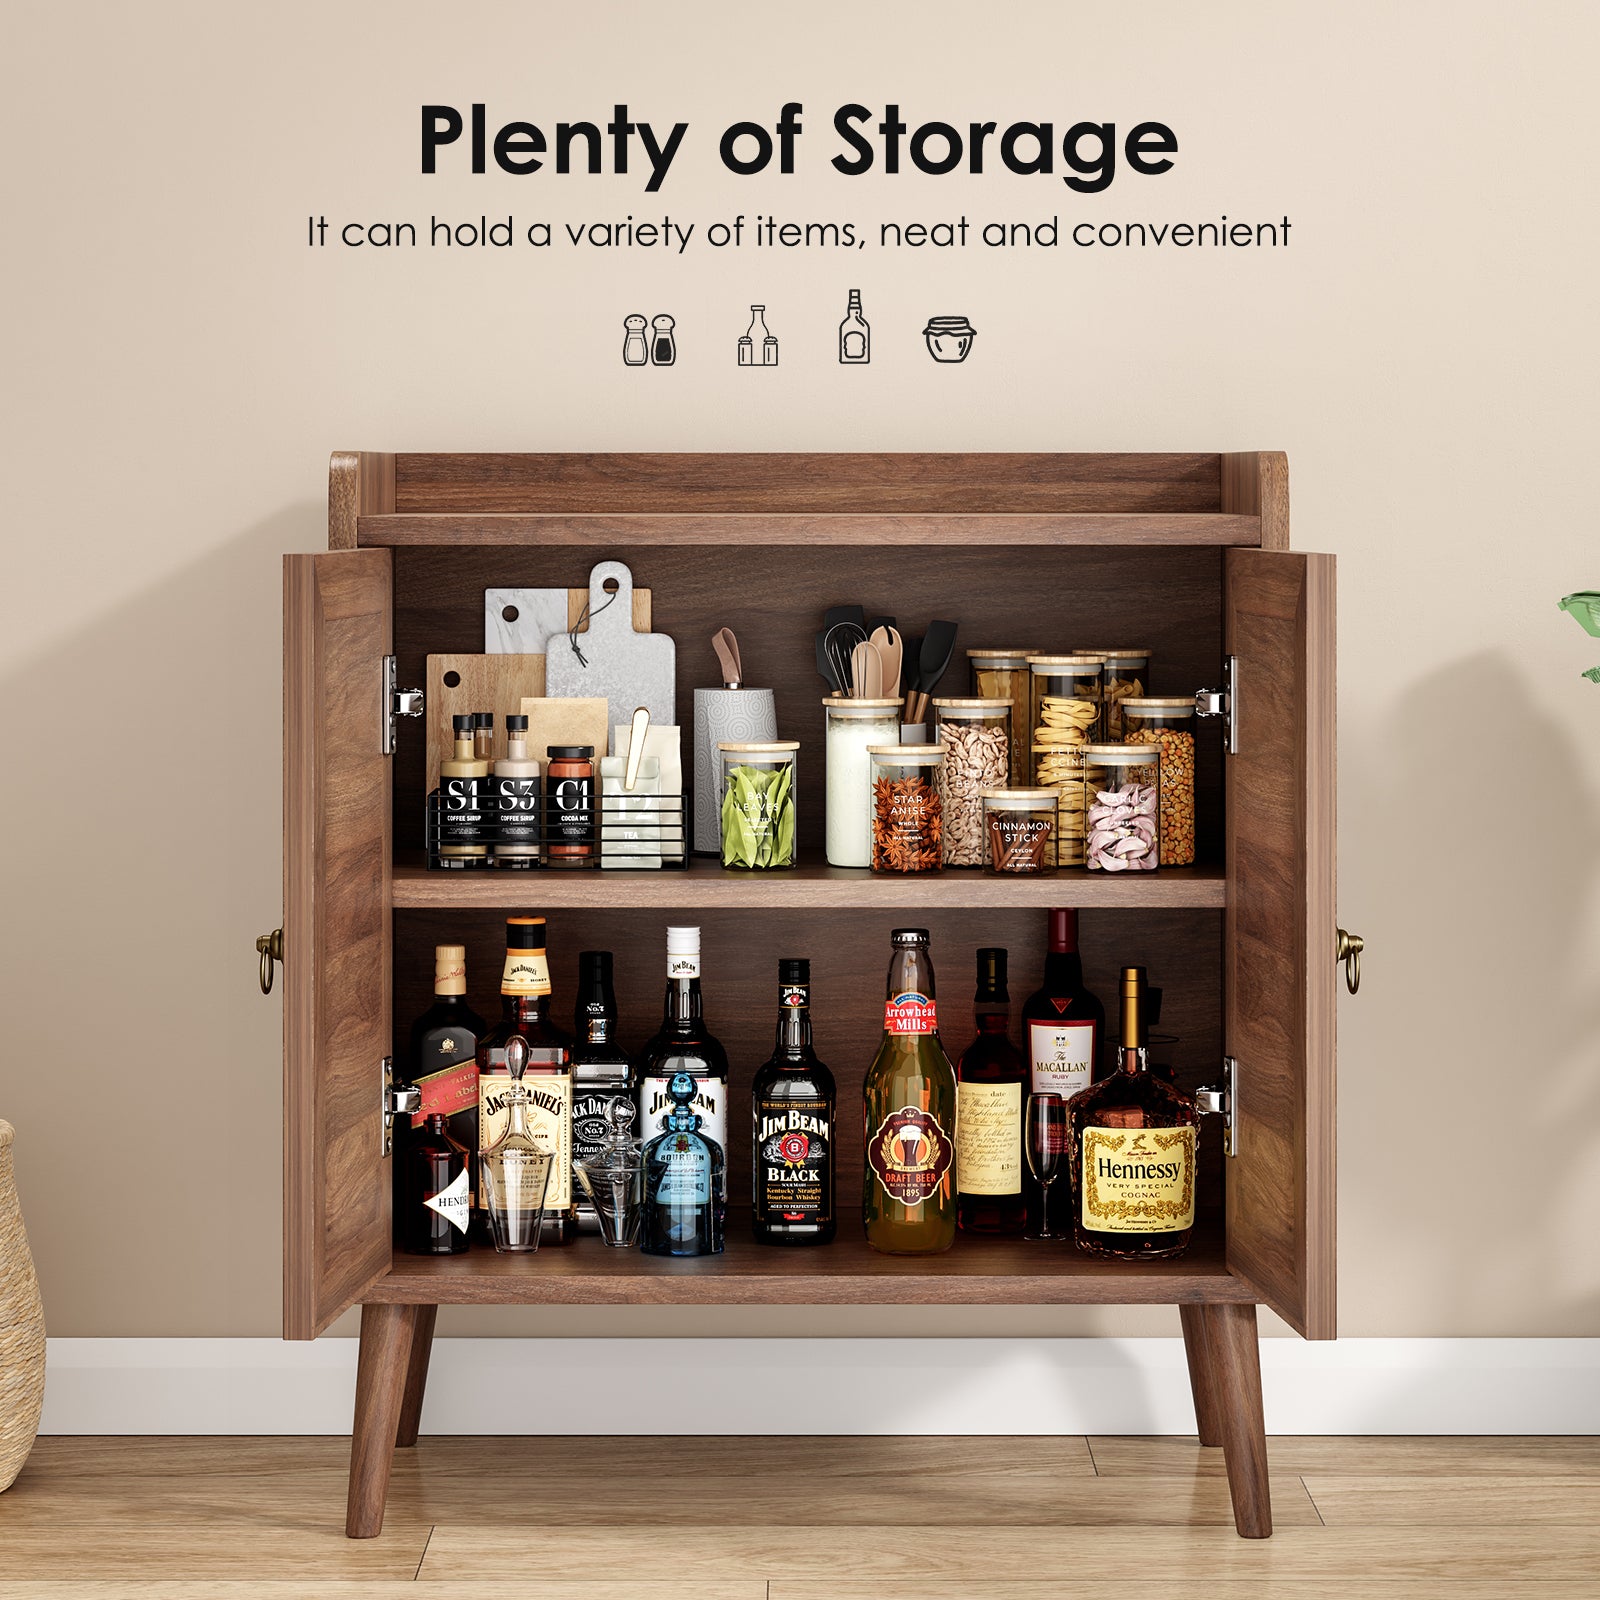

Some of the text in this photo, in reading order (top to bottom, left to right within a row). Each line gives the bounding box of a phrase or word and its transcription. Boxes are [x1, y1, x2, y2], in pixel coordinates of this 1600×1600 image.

[956, 780, 995, 788] BEANS
[447, 780, 480, 811] S1
[499, 780, 535, 811] S3
[556, 780, 590, 811] C1
[748, 792, 769, 800] BAY
[894, 795, 924, 804] STAR
[1103, 795, 1146, 804] GARLIC
[738, 803, 779, 811] LEAVES
[890, 806, 927, 815] ANISE
[1102, 806, 1147, 814] CLOVES
[991, 822, 1052, 831] CINNAMON
[623, 832, 639, 840] TEA
[1004, 833, 1039, 842] STICK
[510, 966, 520, 976] JACK
[672, 963, 681, 973] JIM
[783, 988, 793, 998] JIM
[896, 1018, 927, 1031] Mills
[1053, 1051, 1067, 1062] The
[1036, 1061, 1086, 1072] MACALLAN
[758, 1109, 829, 1143] JIM BEAM
[584, 1127, 604, 1135] No.7
[791, 1143, 799, 1153] B
[767, 1166, 821, 1182] BLACK
[1098, 1157, 1182, 1182] Hennessy
[885, 1172, 937, 1183] DRAFT BEER
[1134, 1182, 1175, 1190] SPECIAL
[766, 1187, 822, 1195] Kentucky Straight
[902, 1188, 920, 1197] 1895
[795, 1194, 821, 1202] Whiskey
